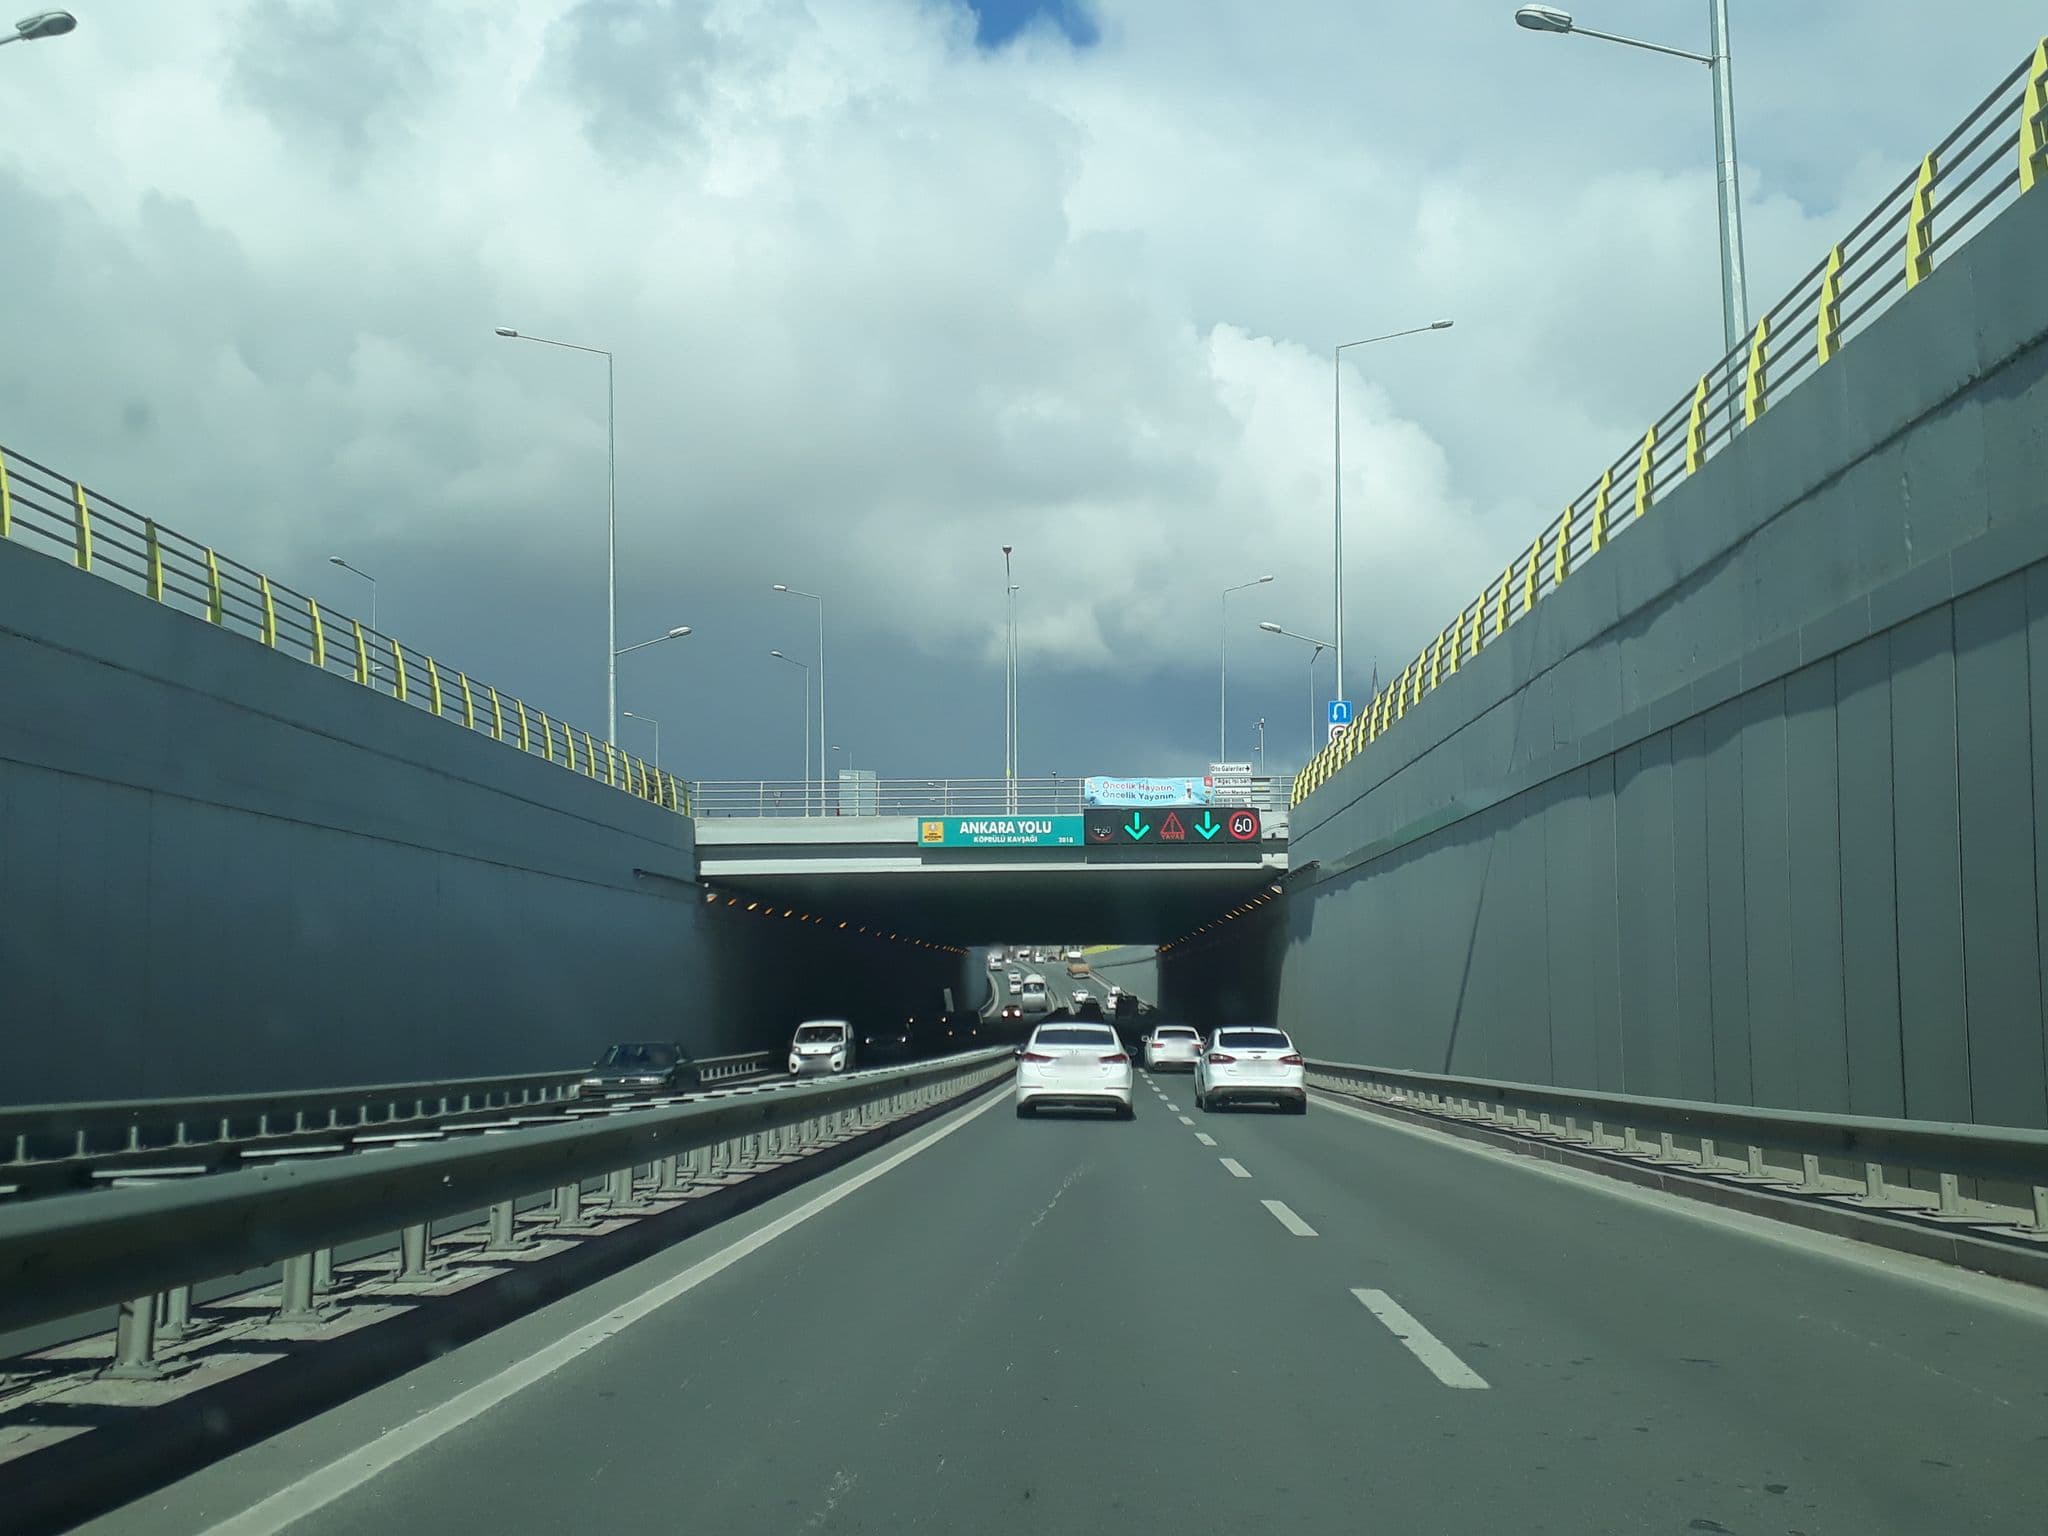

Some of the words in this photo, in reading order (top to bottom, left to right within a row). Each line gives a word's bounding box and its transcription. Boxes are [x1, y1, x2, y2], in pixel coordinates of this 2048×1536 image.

[1103, 781, 1136, 790] Öncelik
[1102, 789, 1136, 799] Öncelik
[1138, 792, 1176, 801] Yayanın.
[959, 821, 1016, 834] ANKARA
[1016, 821, 1052, 834] YOLU
[1234, 818, 1252, 833] 60
[973, 834, 1006, 843] KÖPRÜLÜ
[1007, 834, 1038, 844] KAVŞAĞI
